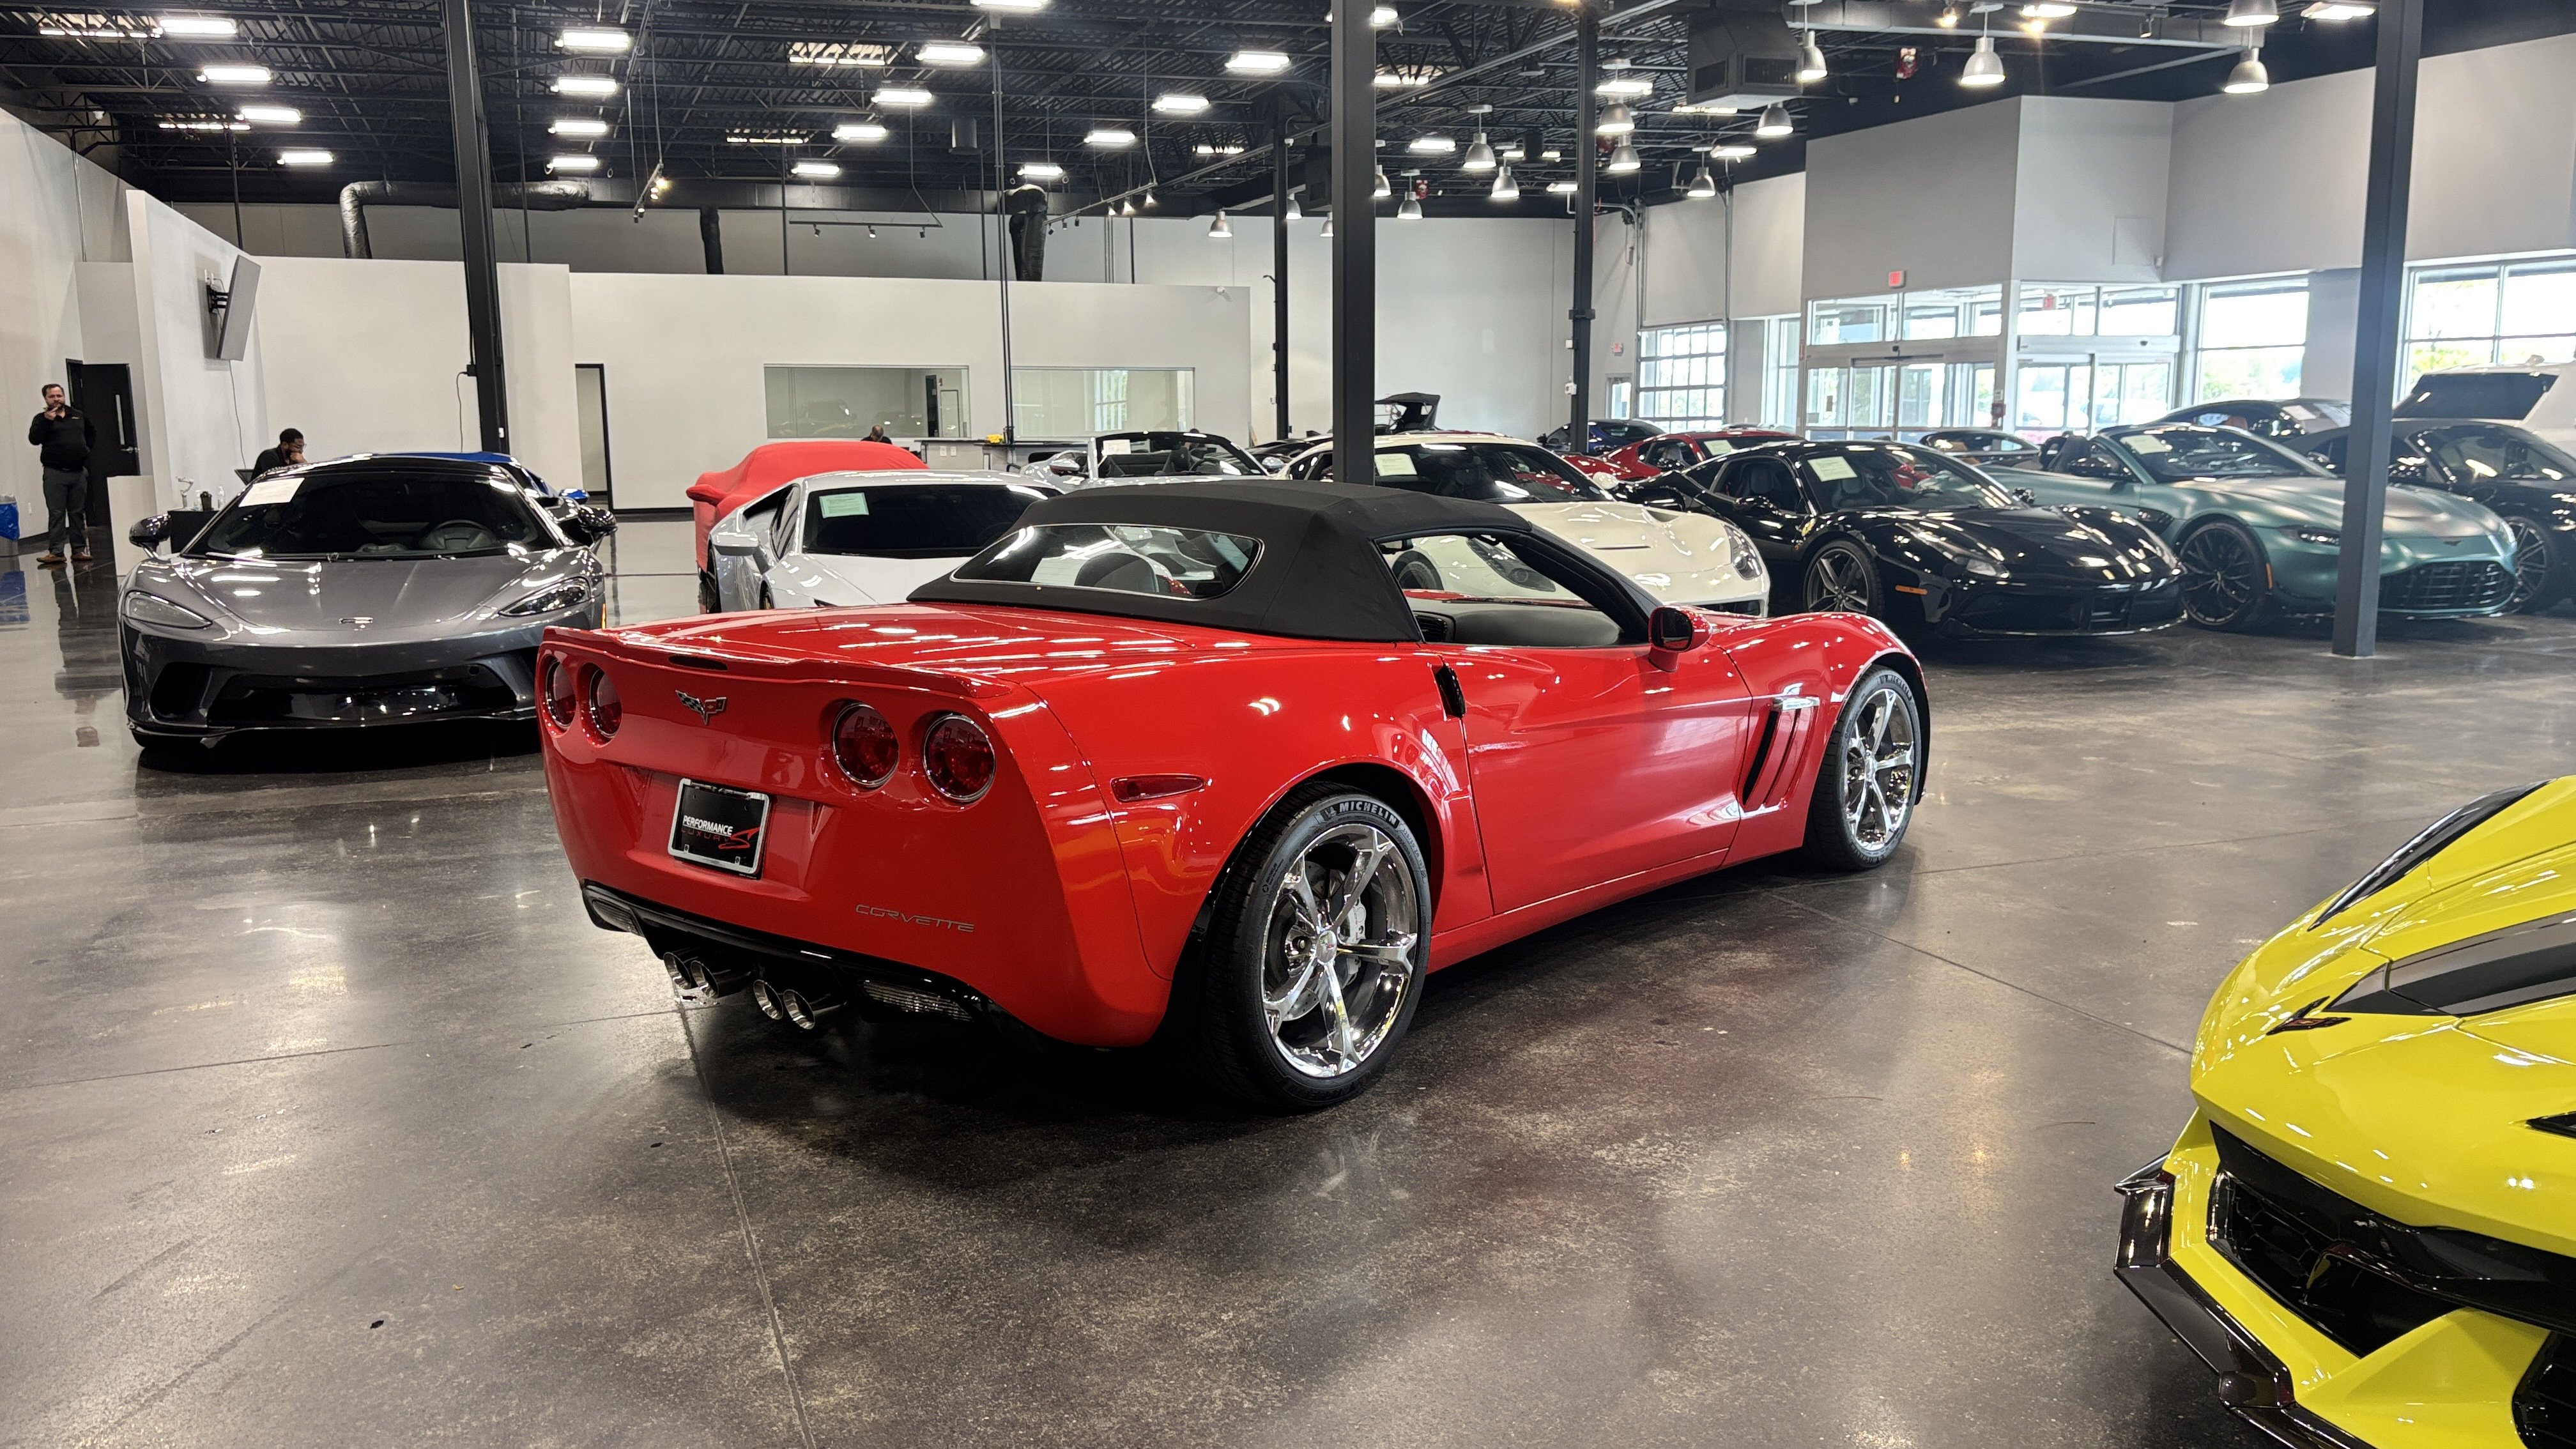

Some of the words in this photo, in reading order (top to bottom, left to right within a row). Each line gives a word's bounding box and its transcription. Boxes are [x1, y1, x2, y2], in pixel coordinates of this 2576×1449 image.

[682, 815, 733, 835] PERFORMANCE
[1339, 801, 1397, 825] MICHELIN
[855, 904, 975, 933] CORVETTE
